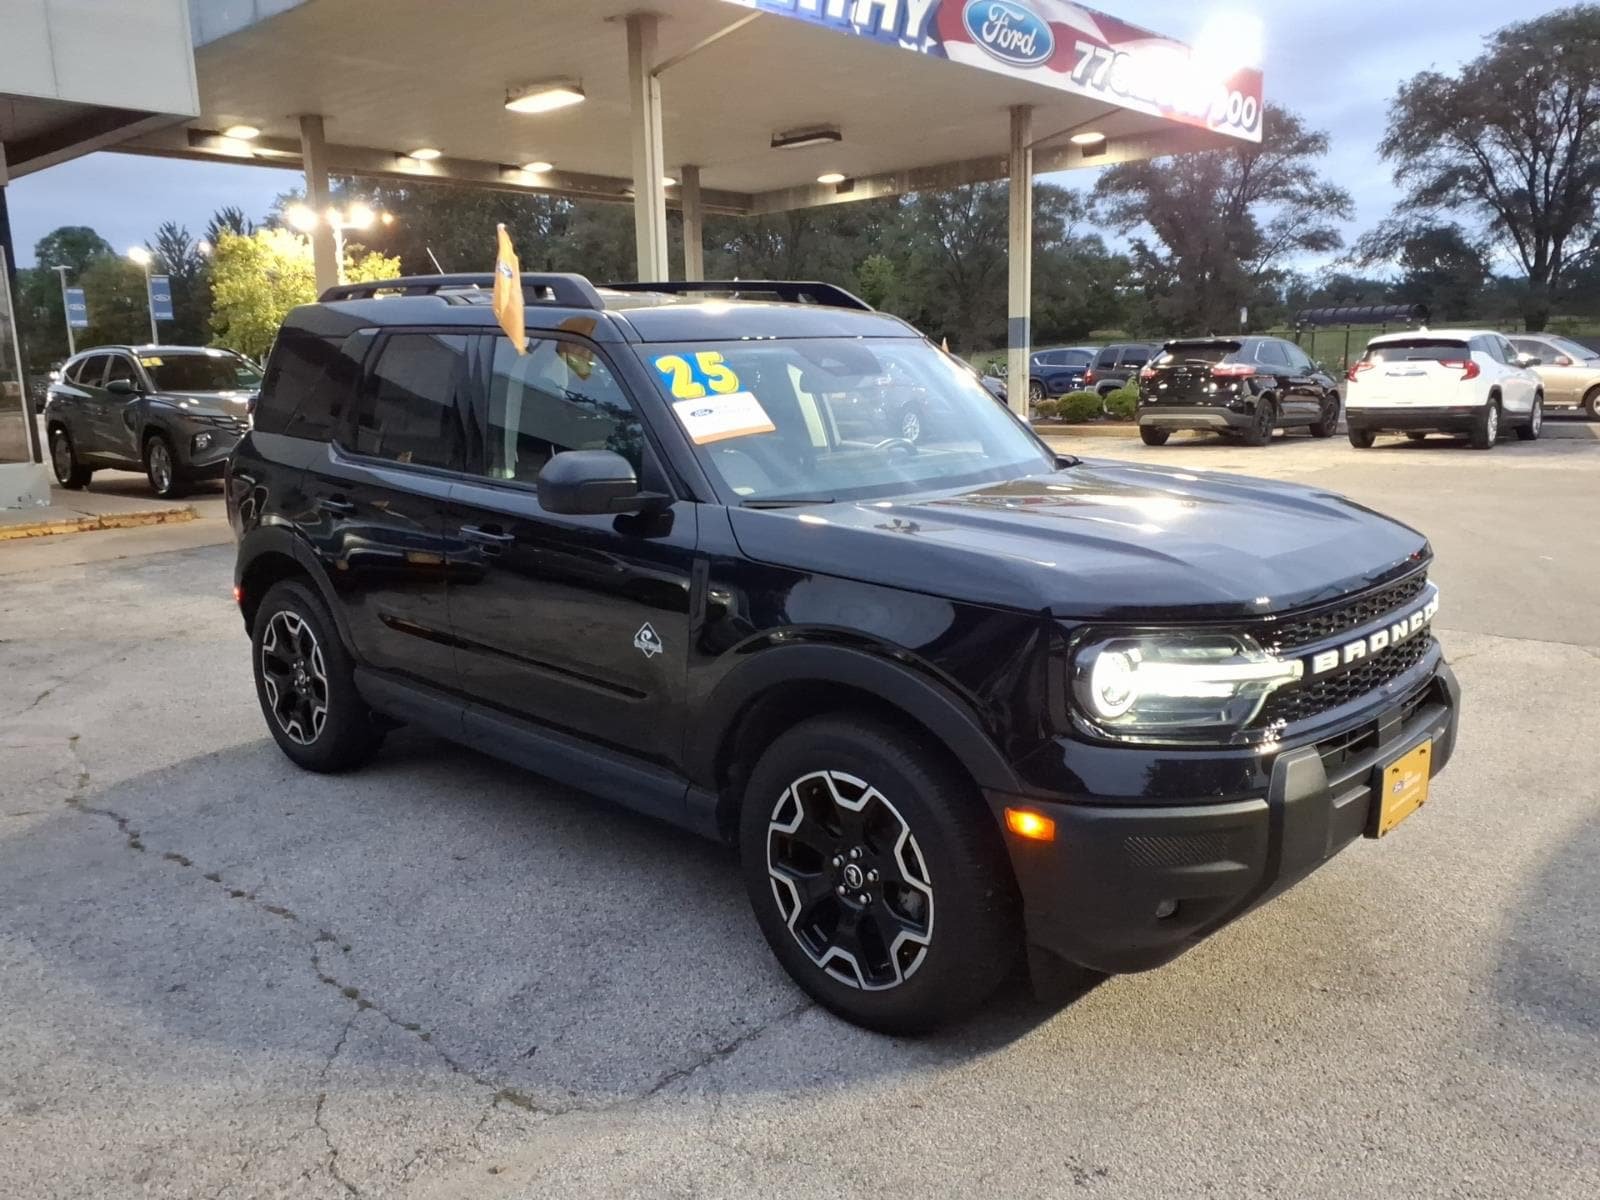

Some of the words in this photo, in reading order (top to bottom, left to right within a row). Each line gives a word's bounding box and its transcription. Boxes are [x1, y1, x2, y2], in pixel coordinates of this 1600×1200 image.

[982, 3, 1037, 56] Ford
[655, 351, 739, 398] 25
[1312, 602, 1436, 675] BRONCO
